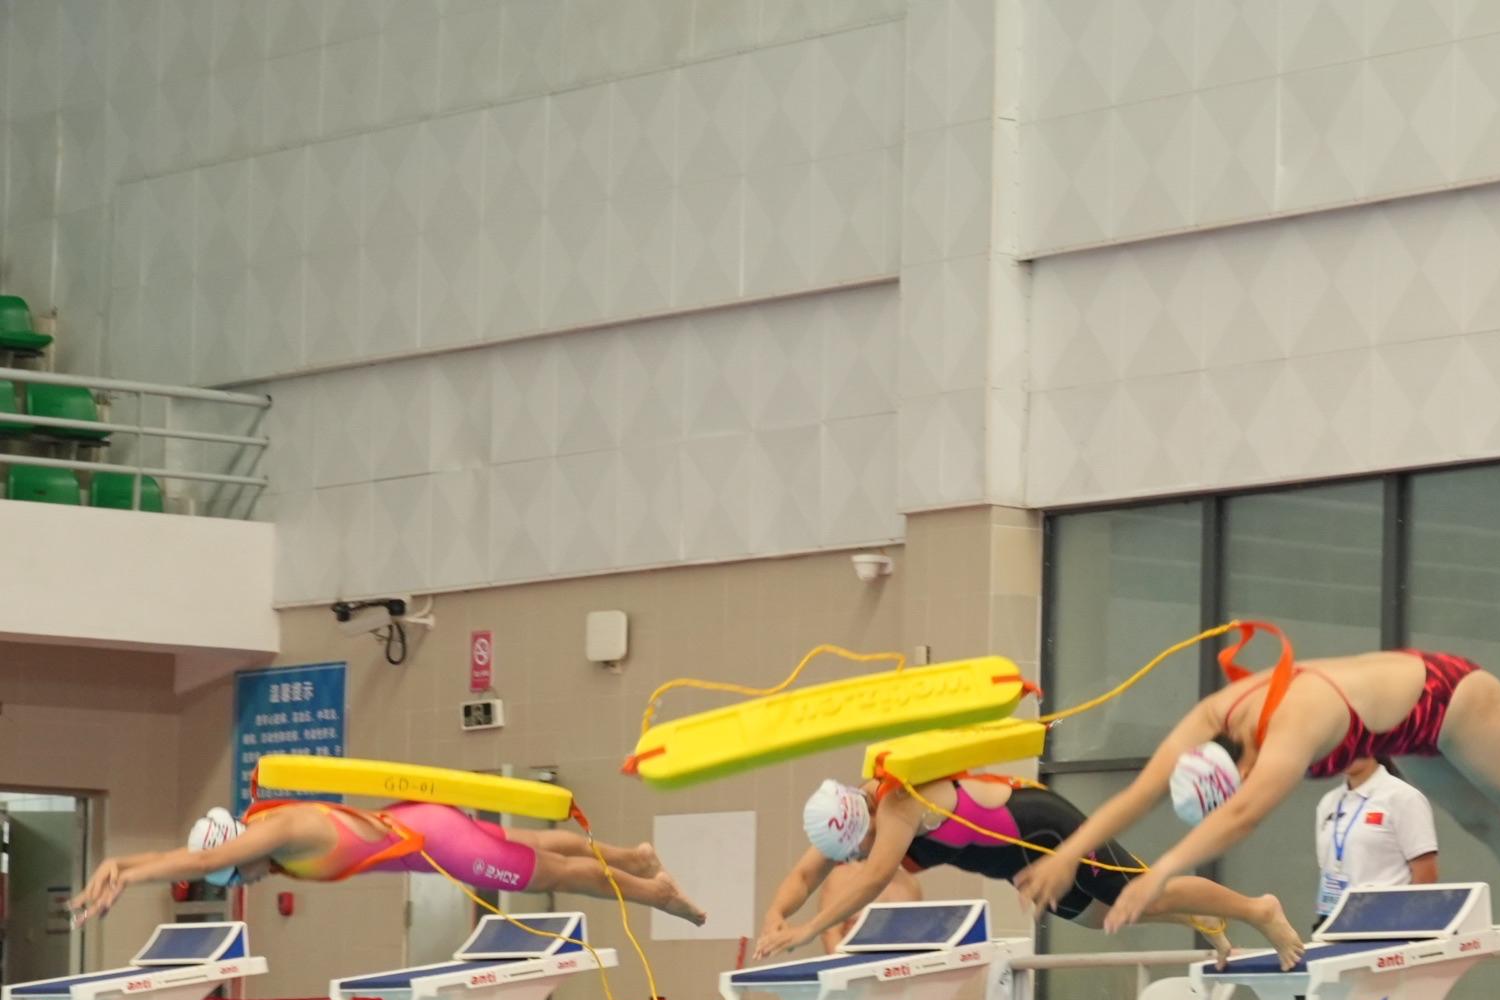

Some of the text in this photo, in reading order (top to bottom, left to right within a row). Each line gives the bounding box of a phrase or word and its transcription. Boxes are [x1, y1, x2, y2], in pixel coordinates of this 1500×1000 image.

[883, 951, 981, 978] anti anti
[1377, 939, 1482, 968] anti anti
[471, 972, 497, 985] anti
